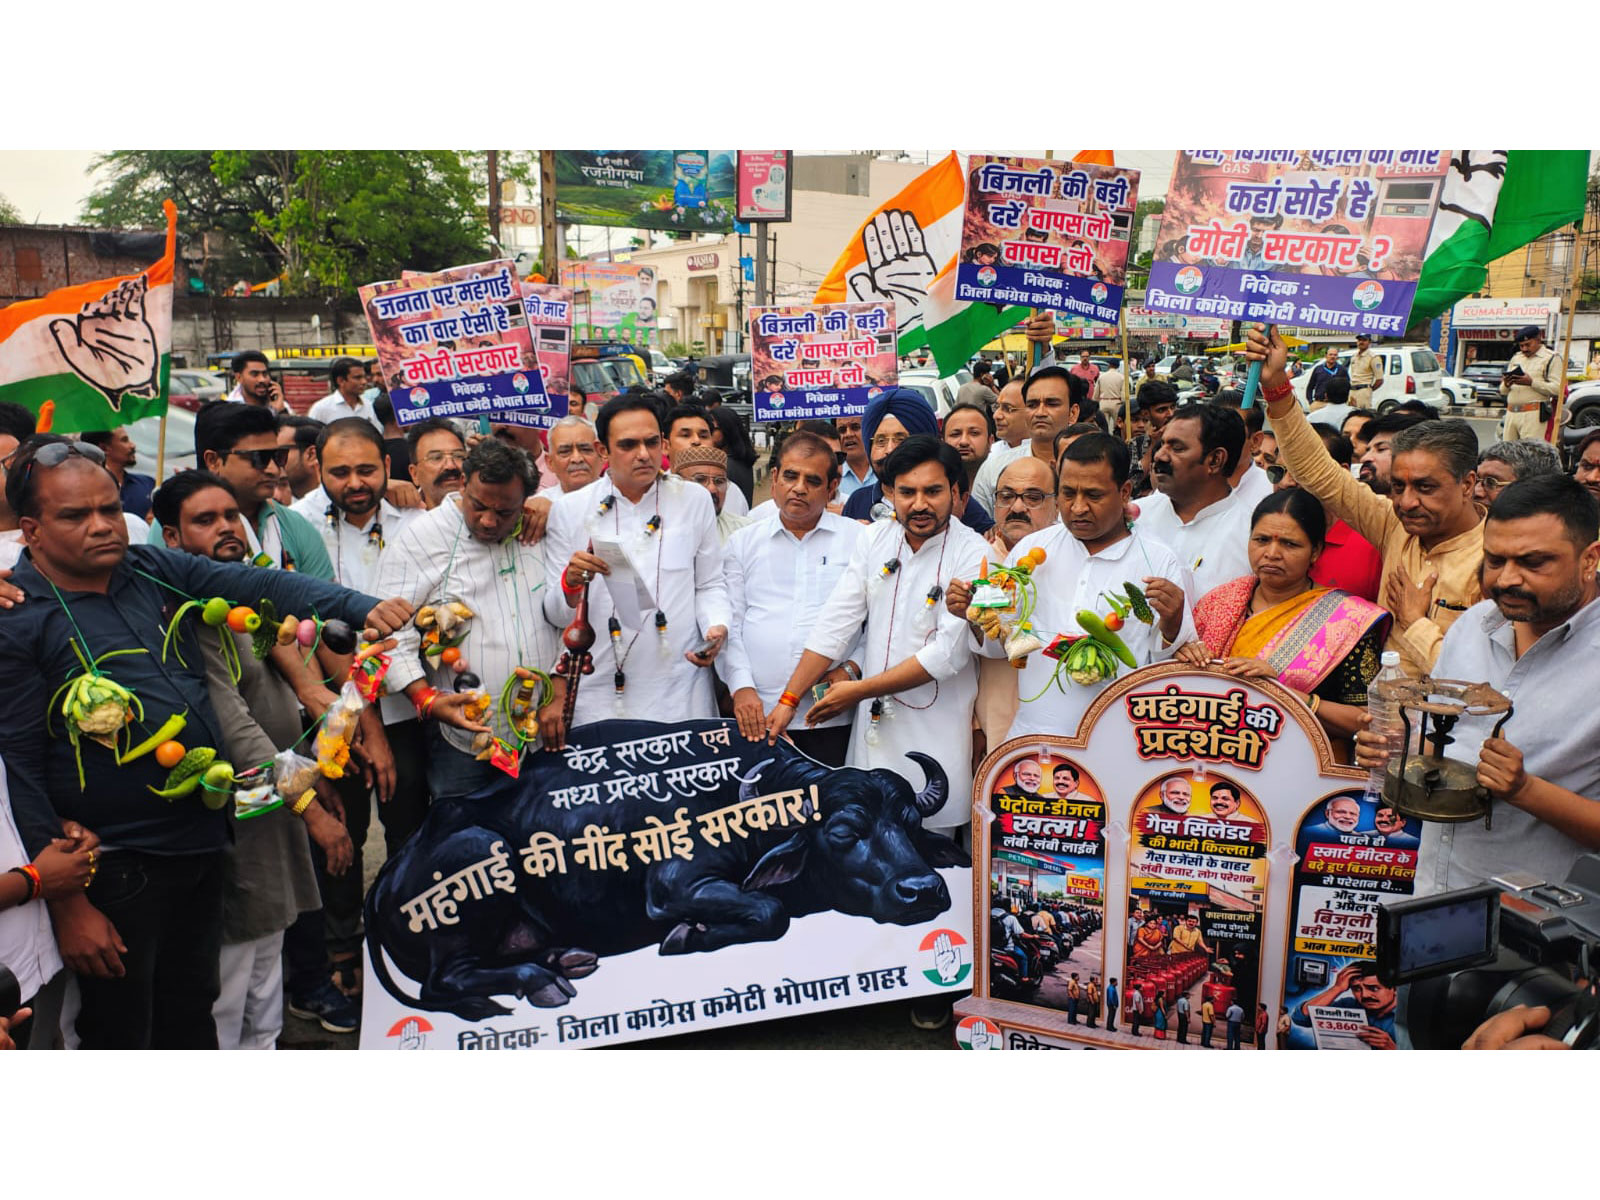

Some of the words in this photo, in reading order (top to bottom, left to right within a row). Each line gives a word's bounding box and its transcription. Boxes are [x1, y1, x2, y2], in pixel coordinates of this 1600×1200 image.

[581, 165, 644, 182] रजनीगन्धा
[1222, 162, 1250, 174] GAS
[982, 164, 1053, 194] बिजली
[1063, 172, 1088, 199] की
[1095, 178, 1127, 210] बड़ी
[1229, 179, 1282, 215] कहां
[1285, 179, 1340, 219] सोई
[1349, 180, 1373, 218] है
[991, 202, 1025, 227] दरें
[1031, 210, 1083, 235] वापस
[1086, 213, 1112, 240] लो
[1187, 222, 1249, 260] मोदी
[1265, 231, 1361, 267] सरकार
[1004, 241, 1061, 266] वापस
[1068, 247, 1093, 272] लो
[1024, 273, 1063, 289] निवेदक
[1240, 275, 1299, 296] निवेदक
[375, 290, 430, 318] जनता
[431, 286, 454, 306] पर
[456, 269, 511, 301] महंगाई
[960, 285, 990, 298] जिला
[994, 286, 1029, 302] कांग्रेस
[1032, 291, 1062, 307] कमेटी
[1065, 296, 1095, 316] भोपाल
[1097, 305, 1117, 321] शहर
[525, 296, 541, 315] की
[543, 301, 567, 317] मार
[1149, 289, 1193, 310] जिला
[1196, 294, 1243, 315] कांग्रेस
[1248, 299, 1296, 322] कमेटी
[1300, 304, 1359, 328] भोपाल
[1363, 313, 1402, 332] शहर
[1463, 308, 1502, 316] KUMAR
[1506, 307, 1549, 316] STUDIO
[403, 325, 429, 344] का
[431, 321, 458, 339] वार
[461, 307, 492, 334] ऐसी
[493, 306, 509, 330] है
[760, 313, 815, 334] बिजली
[824, 311, 847, 331] की
[855, 309, 886, 333] बड़ी
[1458, 329, 1496, 339] KUMAR
[772, 340, 797, 360] दरें
[803, 342, 849, 359] वापस
[851, 337, 877, 356] लो
[405, 350, 454, 381] मोदी
[455, 345, 520, 374] सरकार
[786, 369, 832, 386] वापस
[839, 364, 864, 383] लो
[452, 382, 486, 397] निवेदक
[806, 393, 839, 403] निवेदक
[399, 407, 430, 424] जिला
[433, 402, 463, 417] कांग्रेस
[466, 397, 491, 412] कमेटी
[493, 393, 524, 409] भोपाल
[525, 393, 545, 406] शहर
[758, 408, 783, 420] जिला
[785, 407, 813, 418] कांग्रेस
[815, 405, 840, 416] कमेटी
[843, 404, 865, 415] भोपा
[1131, 688, 1242, 724] महंगाई
[1245, 706, 1280, 732] की
[563, 744, 610, 774] केंद्र
[612, 730, 696, 768] सरकार
[699, 722, 731, 754] एवं
[1140, 726, 1263, 764] प्रदर्शनी
[548, 783, 601, 810] मध्य
[603, 769, 672, 804] प्रदेश
[663, 757, 762, 797] सरकार
[999, 795, 1101, 818] पेट्रोल-डीजल
[1012, 815, 1088, 838] खत्म!
[1146, 813, 1178, 836] गैस
[1183, 817, 1252, 841] सिलेंडर
[1003, 835, 1059, 852] लंबी-लंबी
[1149, 835, 1165, 848] की
[1169, 838, 1199, 851] भारी
[1201, 841, 1255, 857] किल्लत!
[1340, 834, 1369, 846] पहले
[1372, 835, 1386, 847] ही
[400, 840, 517, 934] महंगाई
[519, 831, 569, 878] की
[573, 825, 630, 872] नींद
[632, 806, 697, 865] सोई
[695, 784, 822, 849] सरकार!
[1008, 853, 1034, 865] PETROL
[1145, 850, 1166, 863] गैस
[1168, 851, 1203, 867] एजेंसी
[1206, 856, 1218, 868] के
[1313, 846, 1355, 860] स्मार्ट
[1355, 847, 1395, 863] मीटर
[1397, 851, 1412, 864] के
[1043, 862, 1063, 874] DIESEL
[1140, 862, 1162, 874] लंबी
[1165, 866, 1195, 879] कतार,
[1198, 867, 1218, 880] लोग
[1220, 870, 1256, 884] परेशान
[1327, 862, 1345, 873] हुए
[1347, 861, 1388, 876] बिजली
[1322, 874, 1335, 885] से
[1336, 876, 1379, 888] परेशान
[1070, 887, 1097, 897] EMPTY
[1333, 889, 1357, 901] और
[1358, 893, 1380, 902] अब
[1325, 900, 1331, 909] 1
[1314, 908, 1374, 928] बिजली
[1301, 924, 1323, 938] बड़ी
[1326, 926, 1345, 938] दरें
[1303, 942, 1327, 951] आम
[1328, 944, 1365, 955] आदमी
[557, 1014, 620, 1043] जिला
[701, 984, 766, 1018] कमेटी
[774, 977, 850, 1006] भोपाल
[857, 966, 908, 993] शहर
[1315, 1008, 1342, 1018] बिजली
